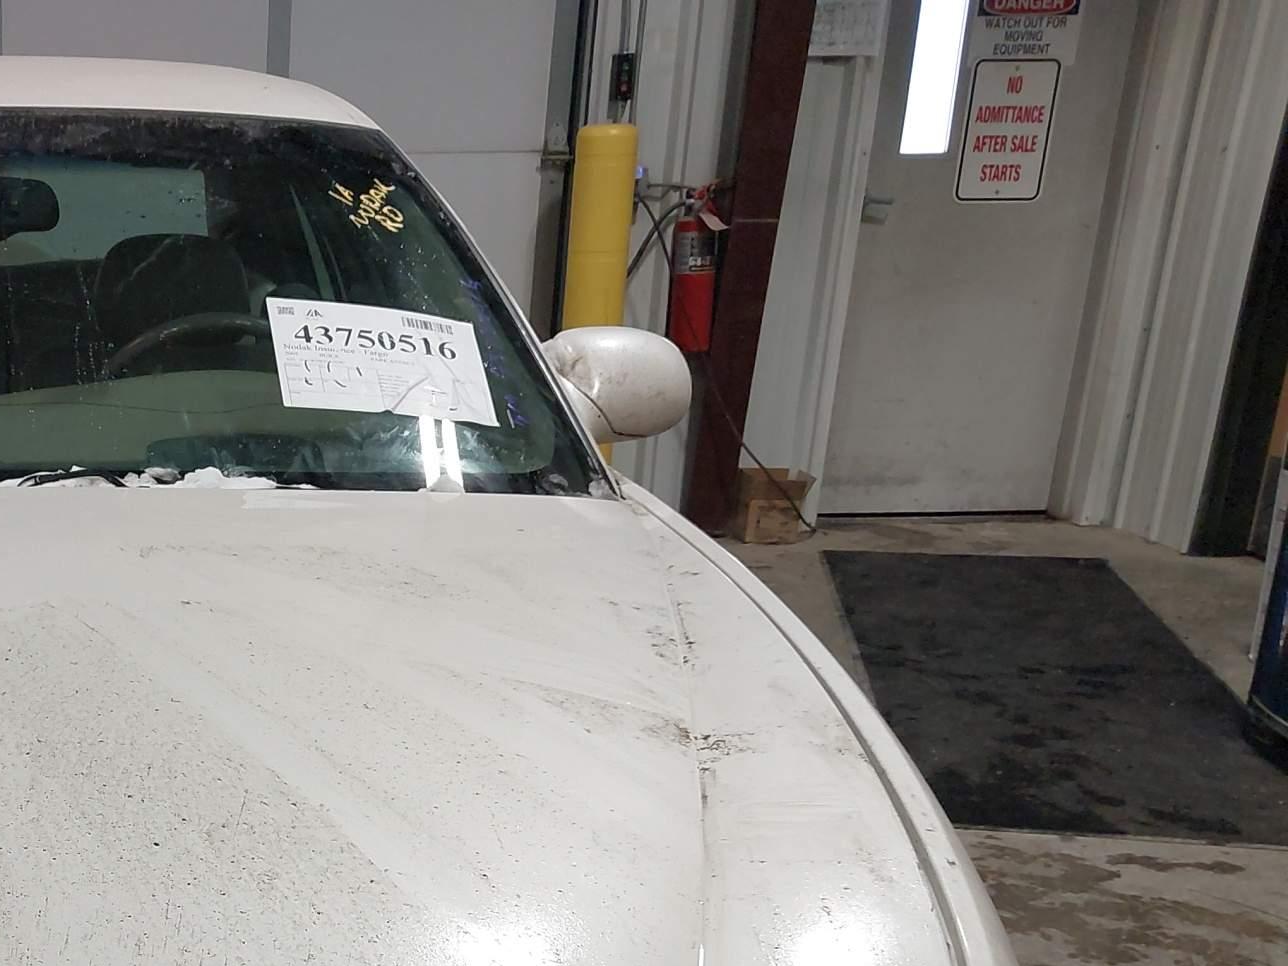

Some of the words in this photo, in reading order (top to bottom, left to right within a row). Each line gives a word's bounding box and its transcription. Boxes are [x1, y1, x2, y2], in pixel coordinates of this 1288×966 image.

[985, 17, 1022, 29] WATCH
[1023, 17, 1043, 28] OUT
[1046, 16, 1068, 28] FOR
[1004, 30, 1044, 42] MOVING
[993, 43, 1051, 56] EQUIPMENT
[1006, 75, 1024, 95] NO
[975, 105, 1046, 124] ADMITTANCE
[972, 135, 1008, 153] AFTER
[1010, 135, 1039, 153] SALE
[979, 164, 1022, 182] STARTS
[294, 324, 457, 360] 43750516
